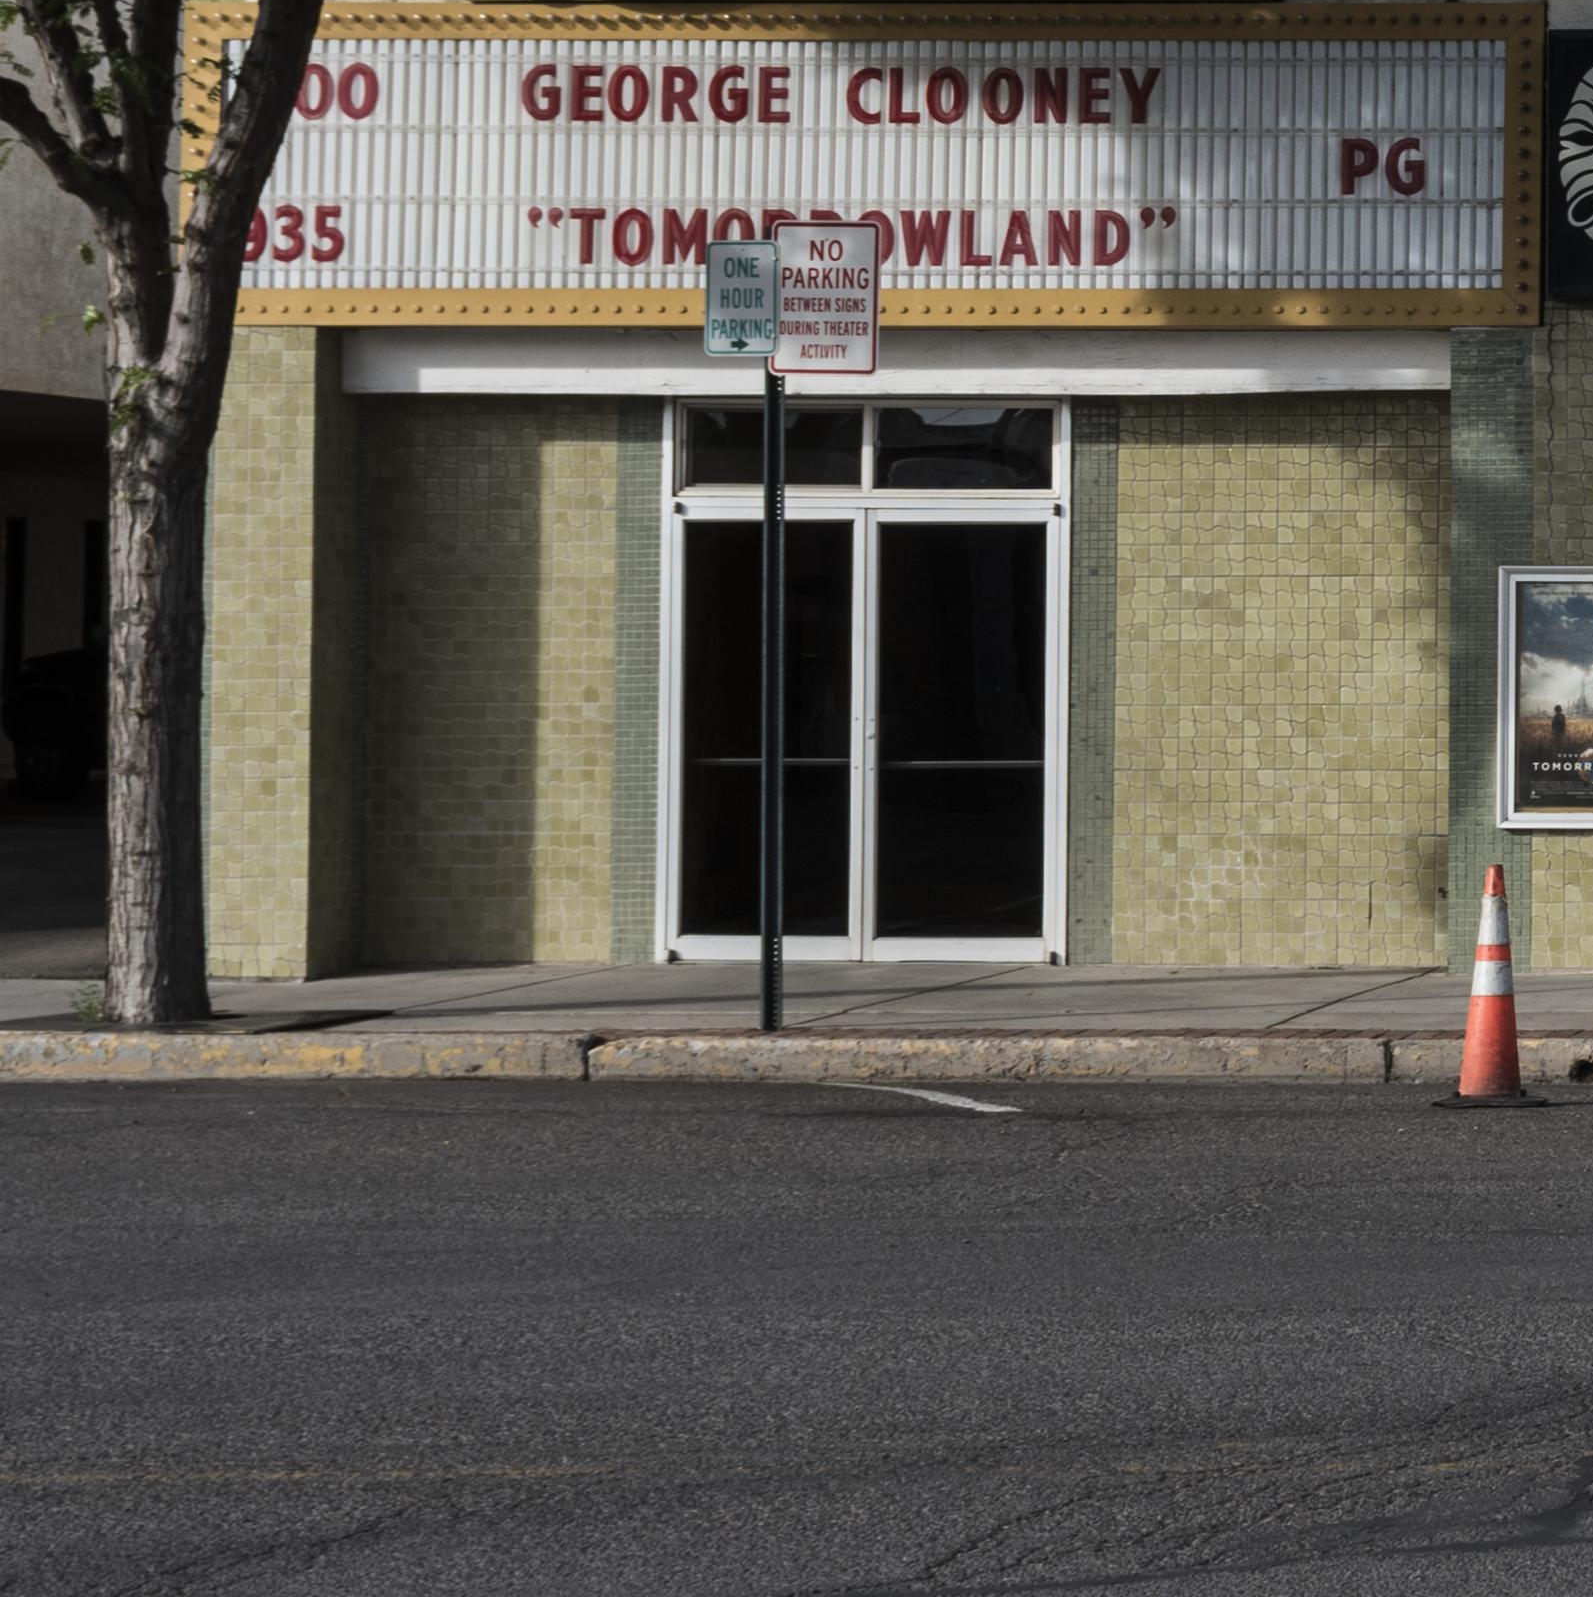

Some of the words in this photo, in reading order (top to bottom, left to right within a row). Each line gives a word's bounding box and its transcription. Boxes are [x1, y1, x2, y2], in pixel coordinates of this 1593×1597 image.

[295, 62, 380, 121] 00
[521, 62, 792, 125] GEORGE
[845, 66, 1163, 126] CLOONEY
[1340, 137, 1426, 197] PG
[242, 203, 346, 264] 935
[527, 205, 1177, 268] "TOMOOWLAND"
[809, 239, 844, 262] NO
[723, 257, 761, 279] ONE
[781, 267, 870, 290] PARKING
[720, 288, 764, 309] HOUR
[783, 297, 831, 313] BETWEEN
[834, 297, 866, 313] SIGNS
[711, 319, 773, 340] PARKING
[779, 320, 820, 336] DURING
[823, 321, 869, 336] THEATER
[799, 343, 848, 359] ACTIVITY
